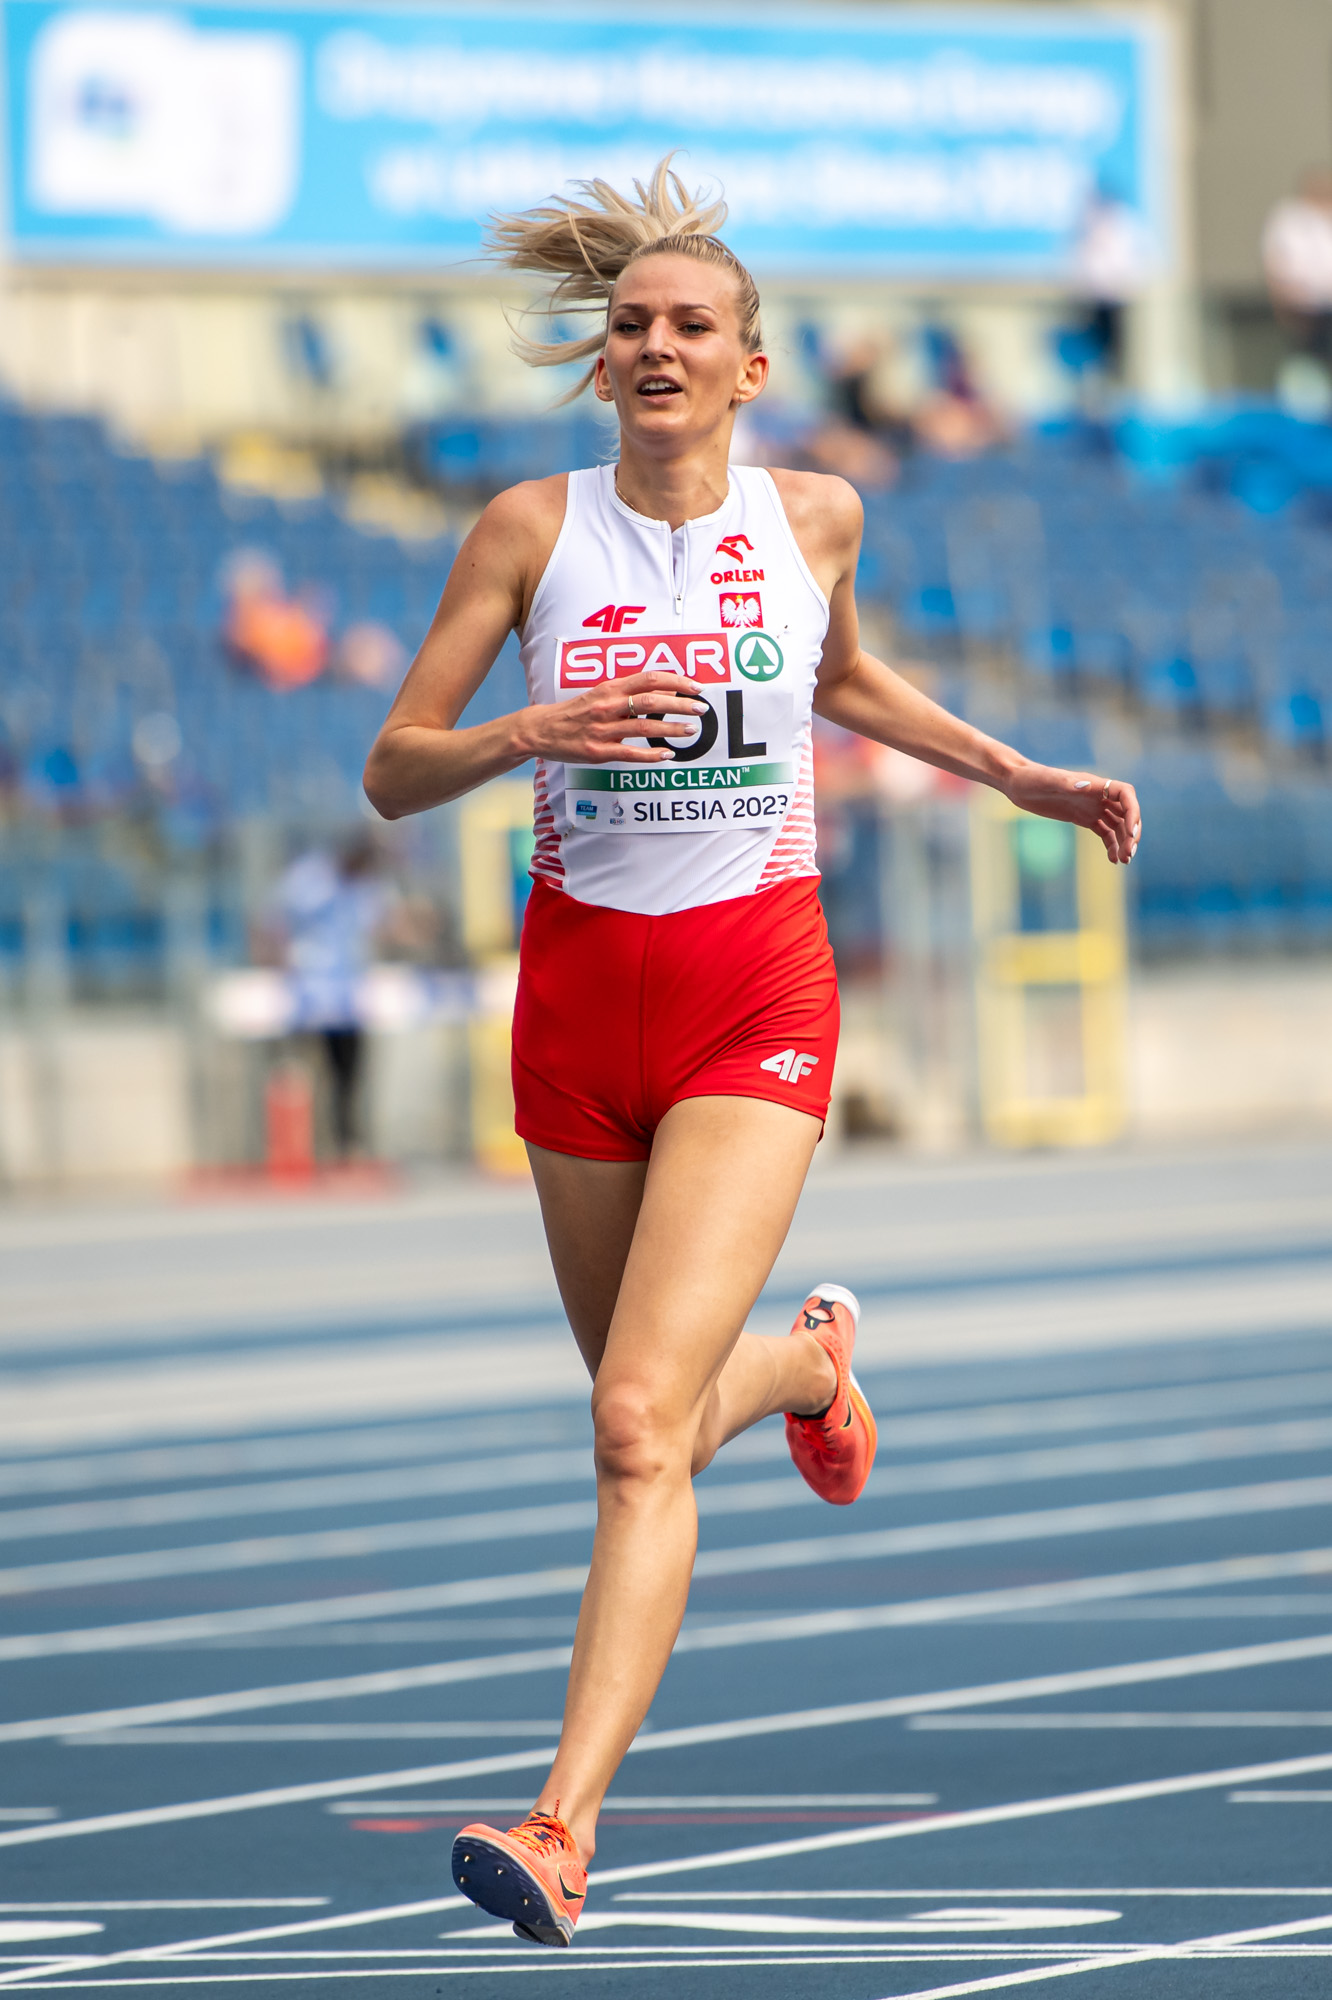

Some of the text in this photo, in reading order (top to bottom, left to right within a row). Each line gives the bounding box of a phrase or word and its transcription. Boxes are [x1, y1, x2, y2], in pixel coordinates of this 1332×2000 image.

[710, 569, 765, 585] ORLEN
[582, 604, 647, 633] 4F
[565, 640, 726, 681] SPAR
[628, 689, 767, 762] OL
[610, 774, 615, 789] I
[619, 772, 667, 789] RUN
[633, 794, 788, 822] SILESIA 2023
[760, 1048, 819, 1084] 4F
